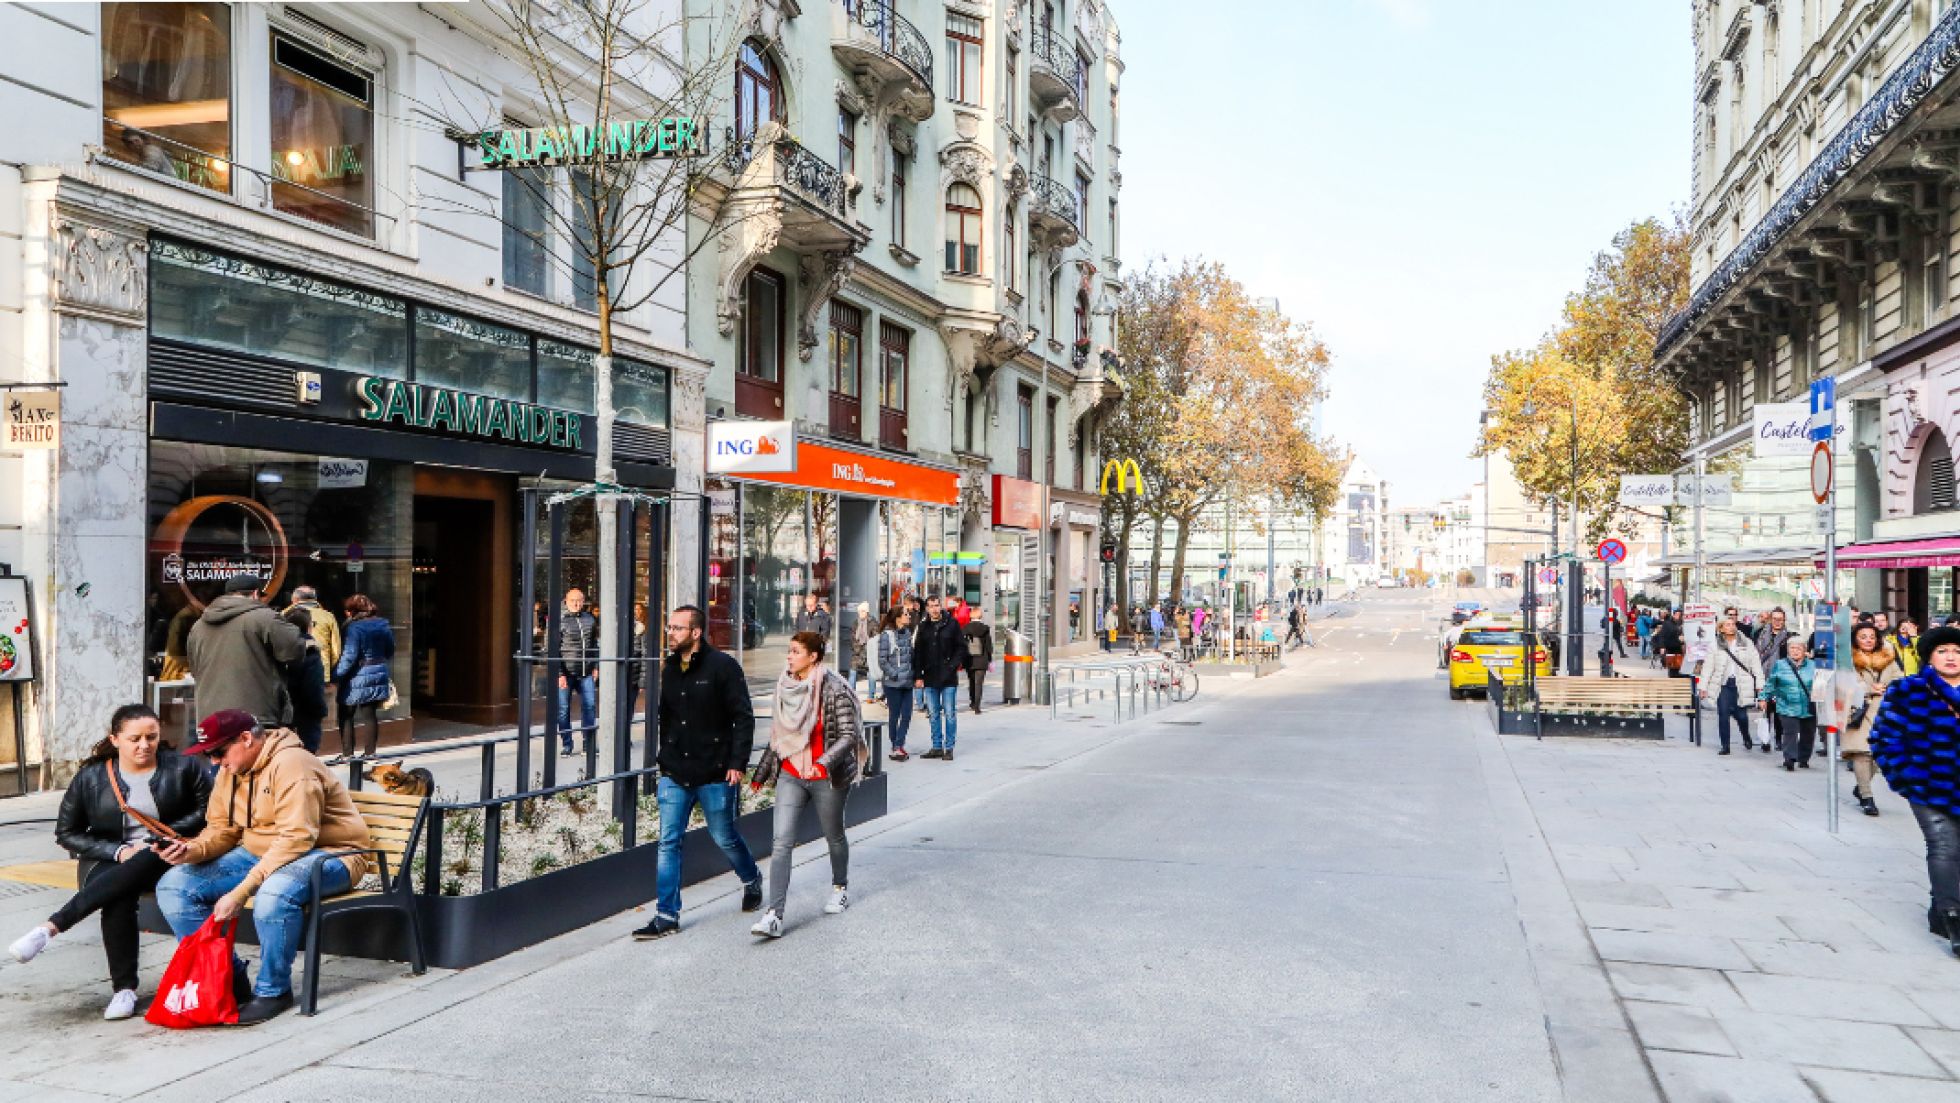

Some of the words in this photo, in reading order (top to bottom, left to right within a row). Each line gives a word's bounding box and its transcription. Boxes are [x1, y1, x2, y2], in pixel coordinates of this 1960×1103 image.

[480, 117, 699, 164] SALAMANDER
[360, 376, 582, 450] SALAMANDER
[717, 439, 753, 455] ING
[832, 463, 851, 481] ING
